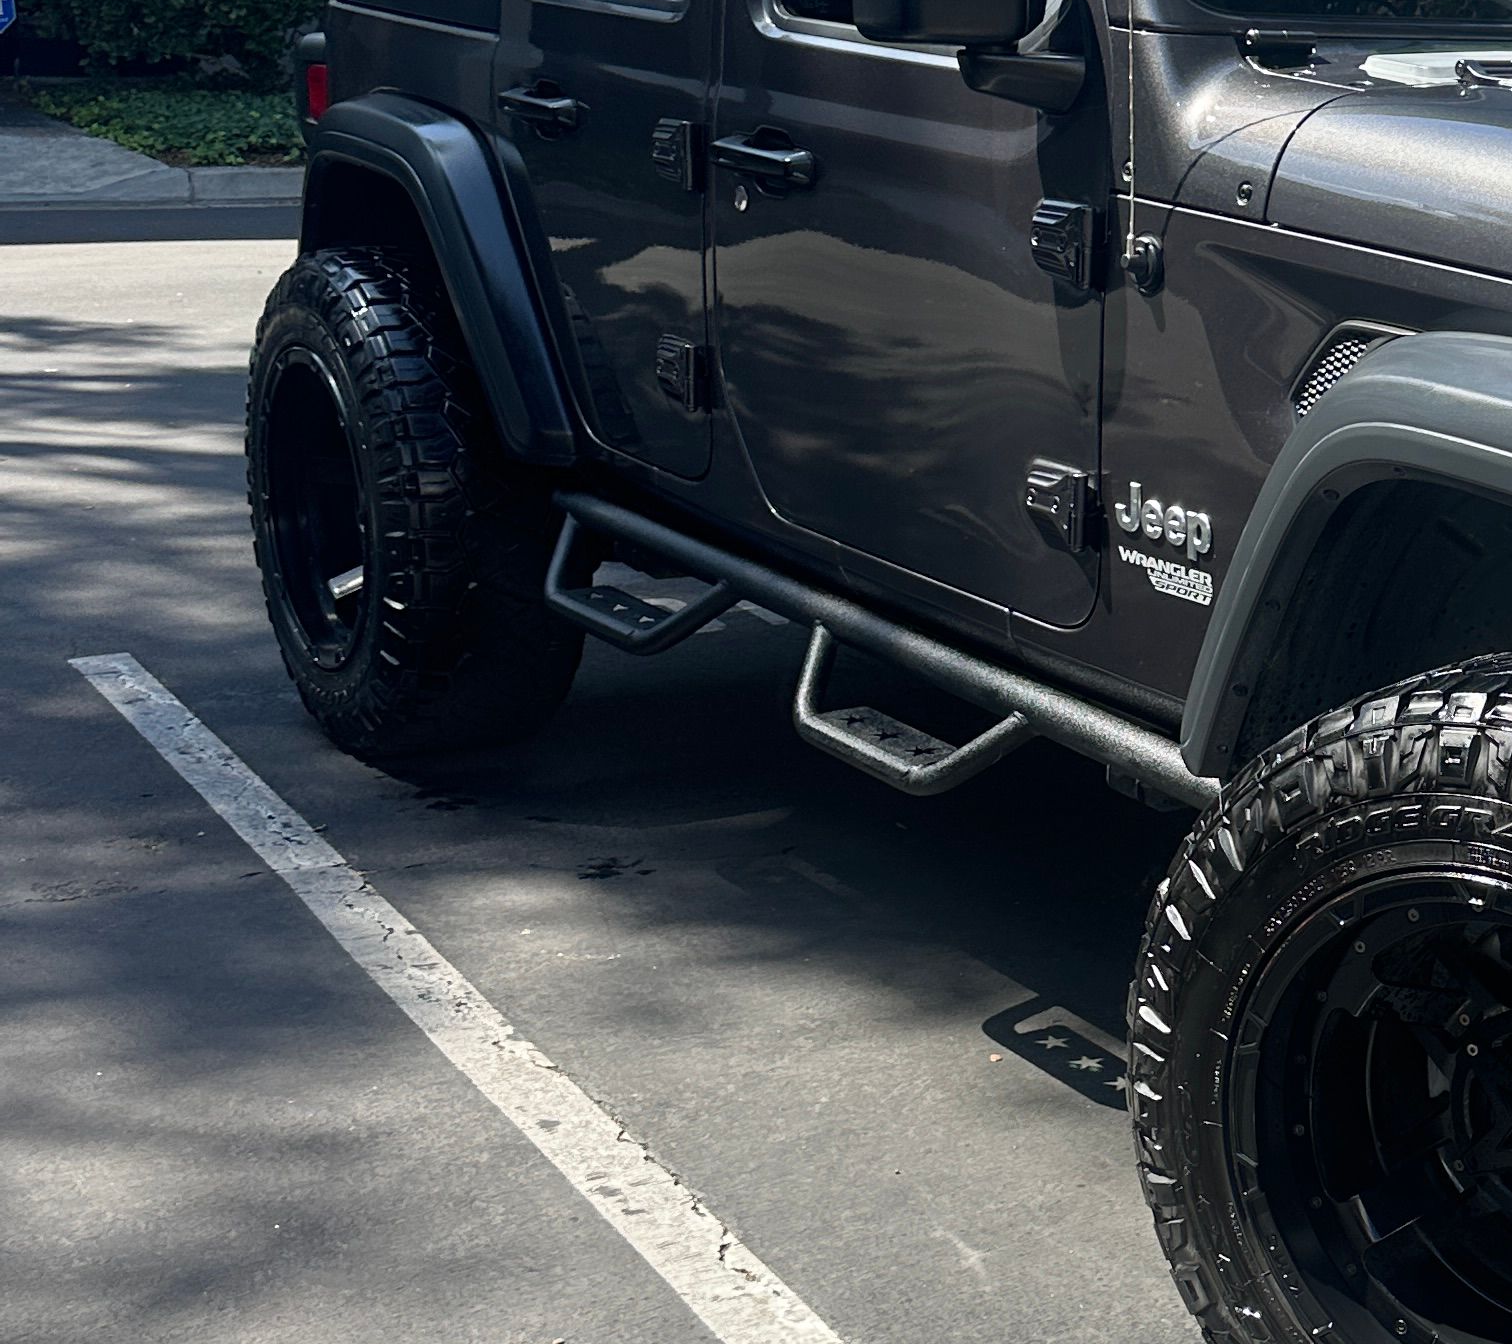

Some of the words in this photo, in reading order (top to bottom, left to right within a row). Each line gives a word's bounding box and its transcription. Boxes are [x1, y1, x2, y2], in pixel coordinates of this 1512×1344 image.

[1114, 481, 1212, 561] Jeep
[1118, 545, 1213, 588] WRANGLER
[1147, 568, 1213, 594] UNLIMITED
[1154, 580, 1212, 603] SPORT
